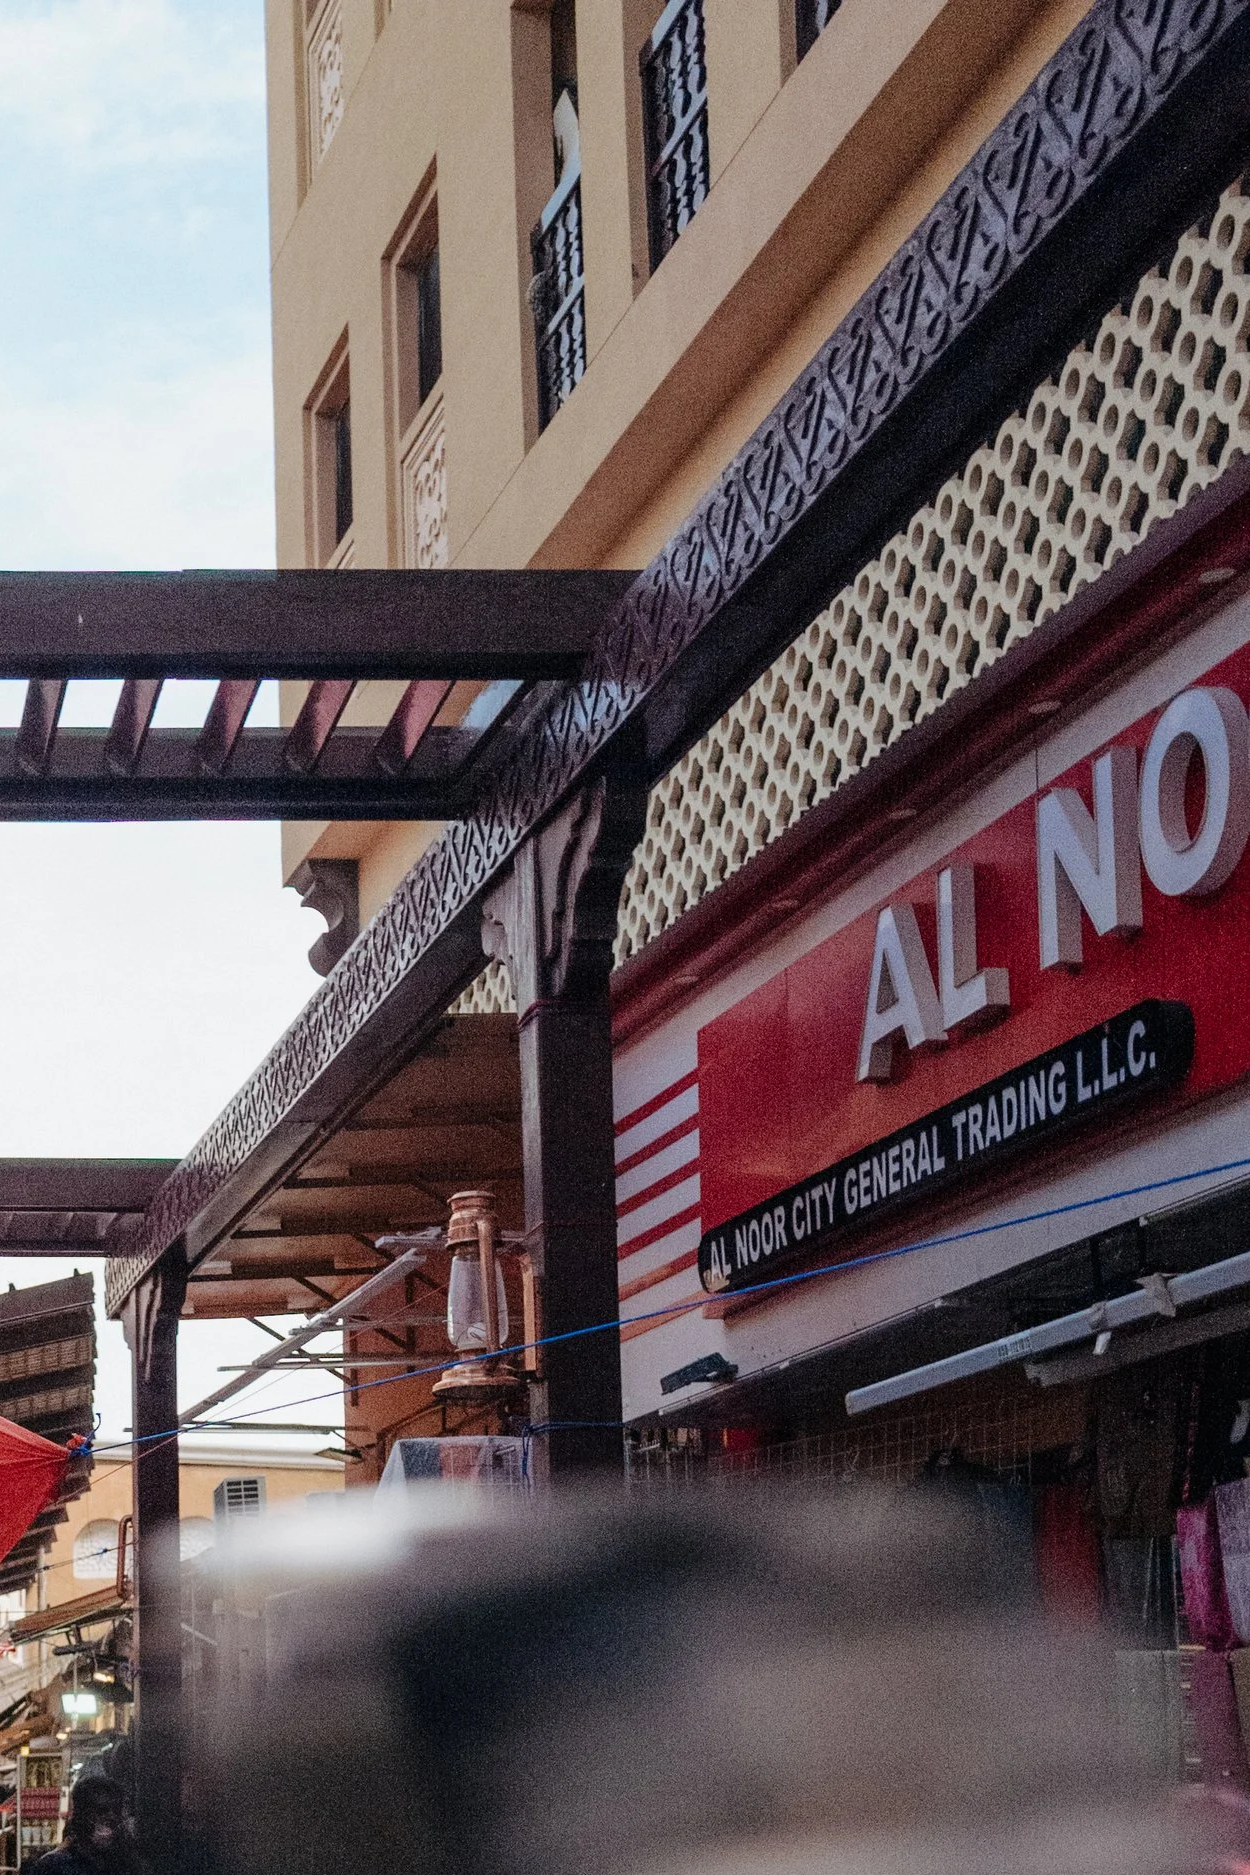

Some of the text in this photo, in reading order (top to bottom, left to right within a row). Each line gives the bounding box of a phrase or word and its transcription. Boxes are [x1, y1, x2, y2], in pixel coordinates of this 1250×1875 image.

[856, 861, 1010, 1084] AL
[710, 1019, 1157, 1279] AL NOOR CITY GENERAL TRADING L.L.C.
